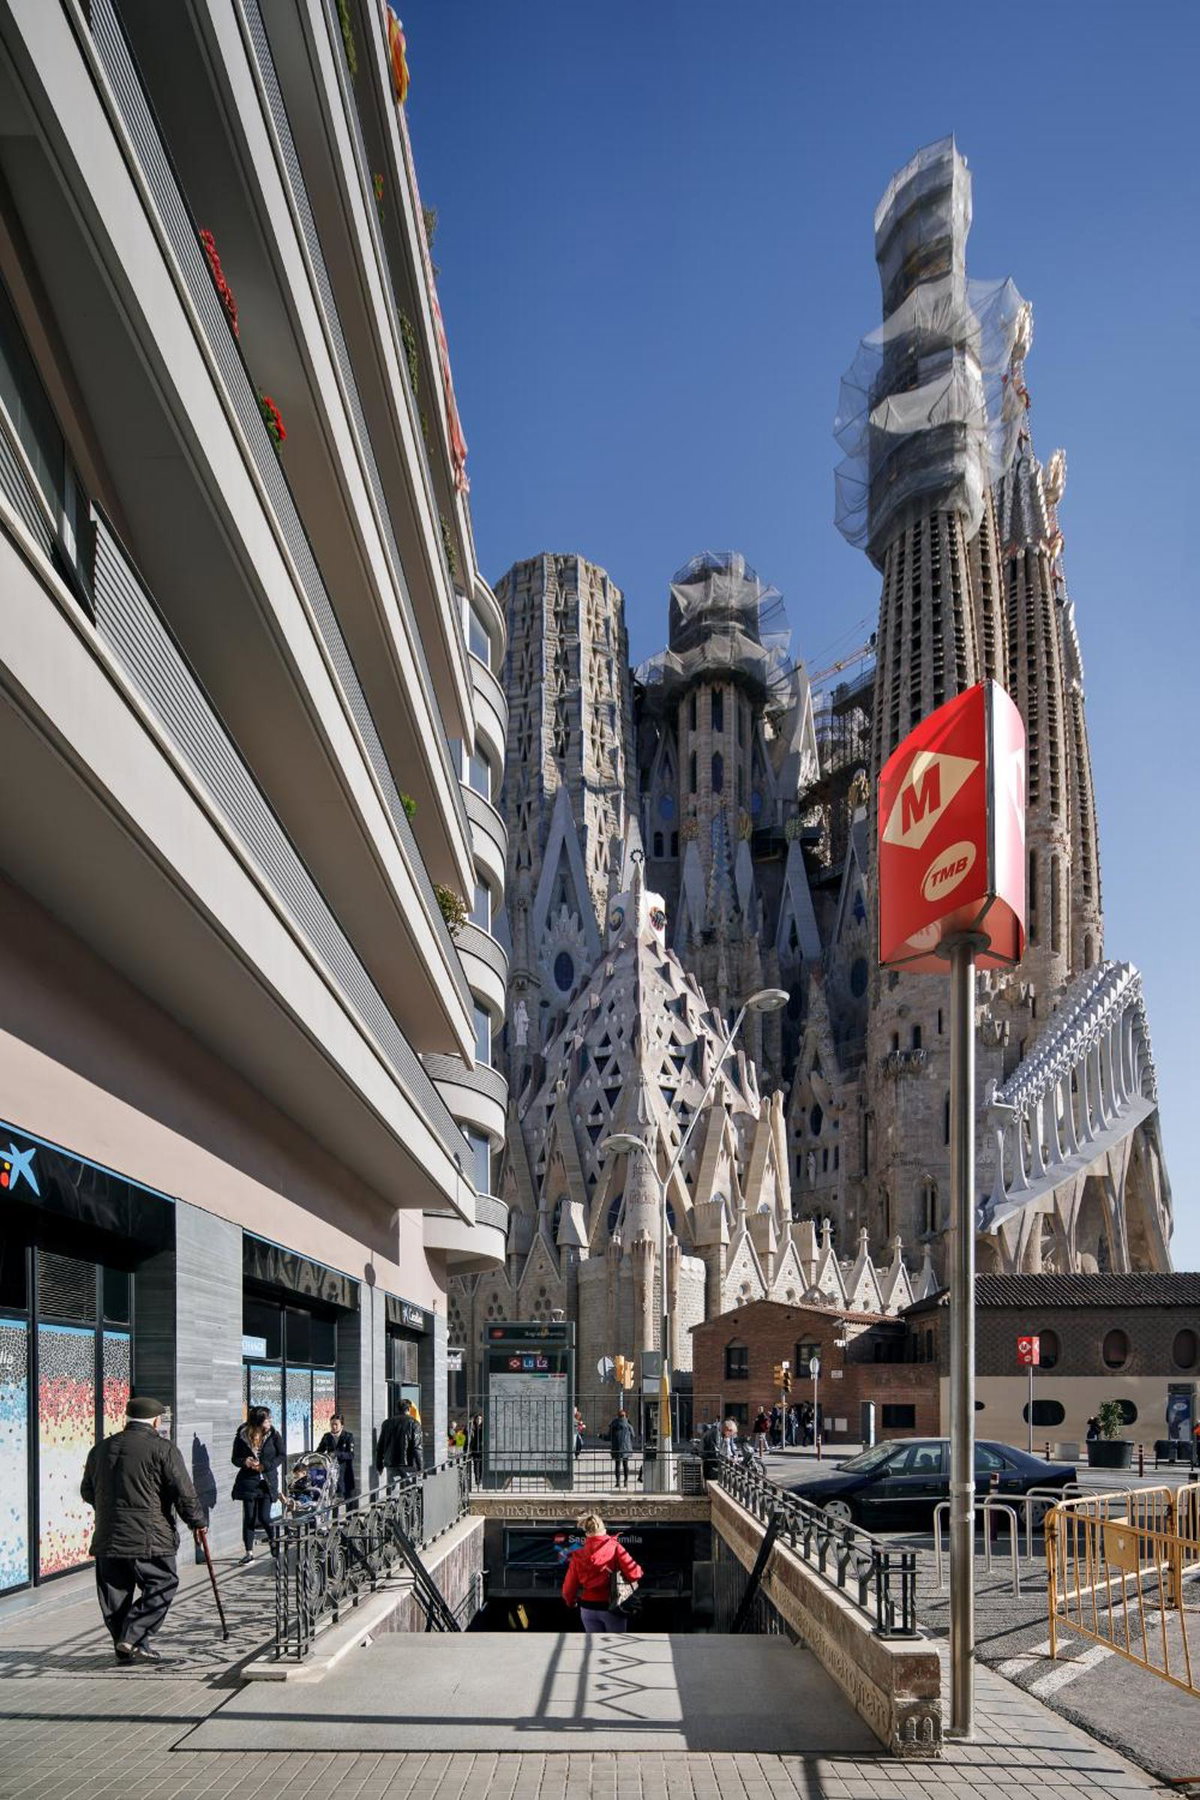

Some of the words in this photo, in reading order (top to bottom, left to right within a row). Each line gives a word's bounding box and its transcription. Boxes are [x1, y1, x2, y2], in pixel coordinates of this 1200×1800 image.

[902, 762, 941, 836] M
[931, 856, 969, 887] TMB
[536, 1360, 548, 1368] L2
